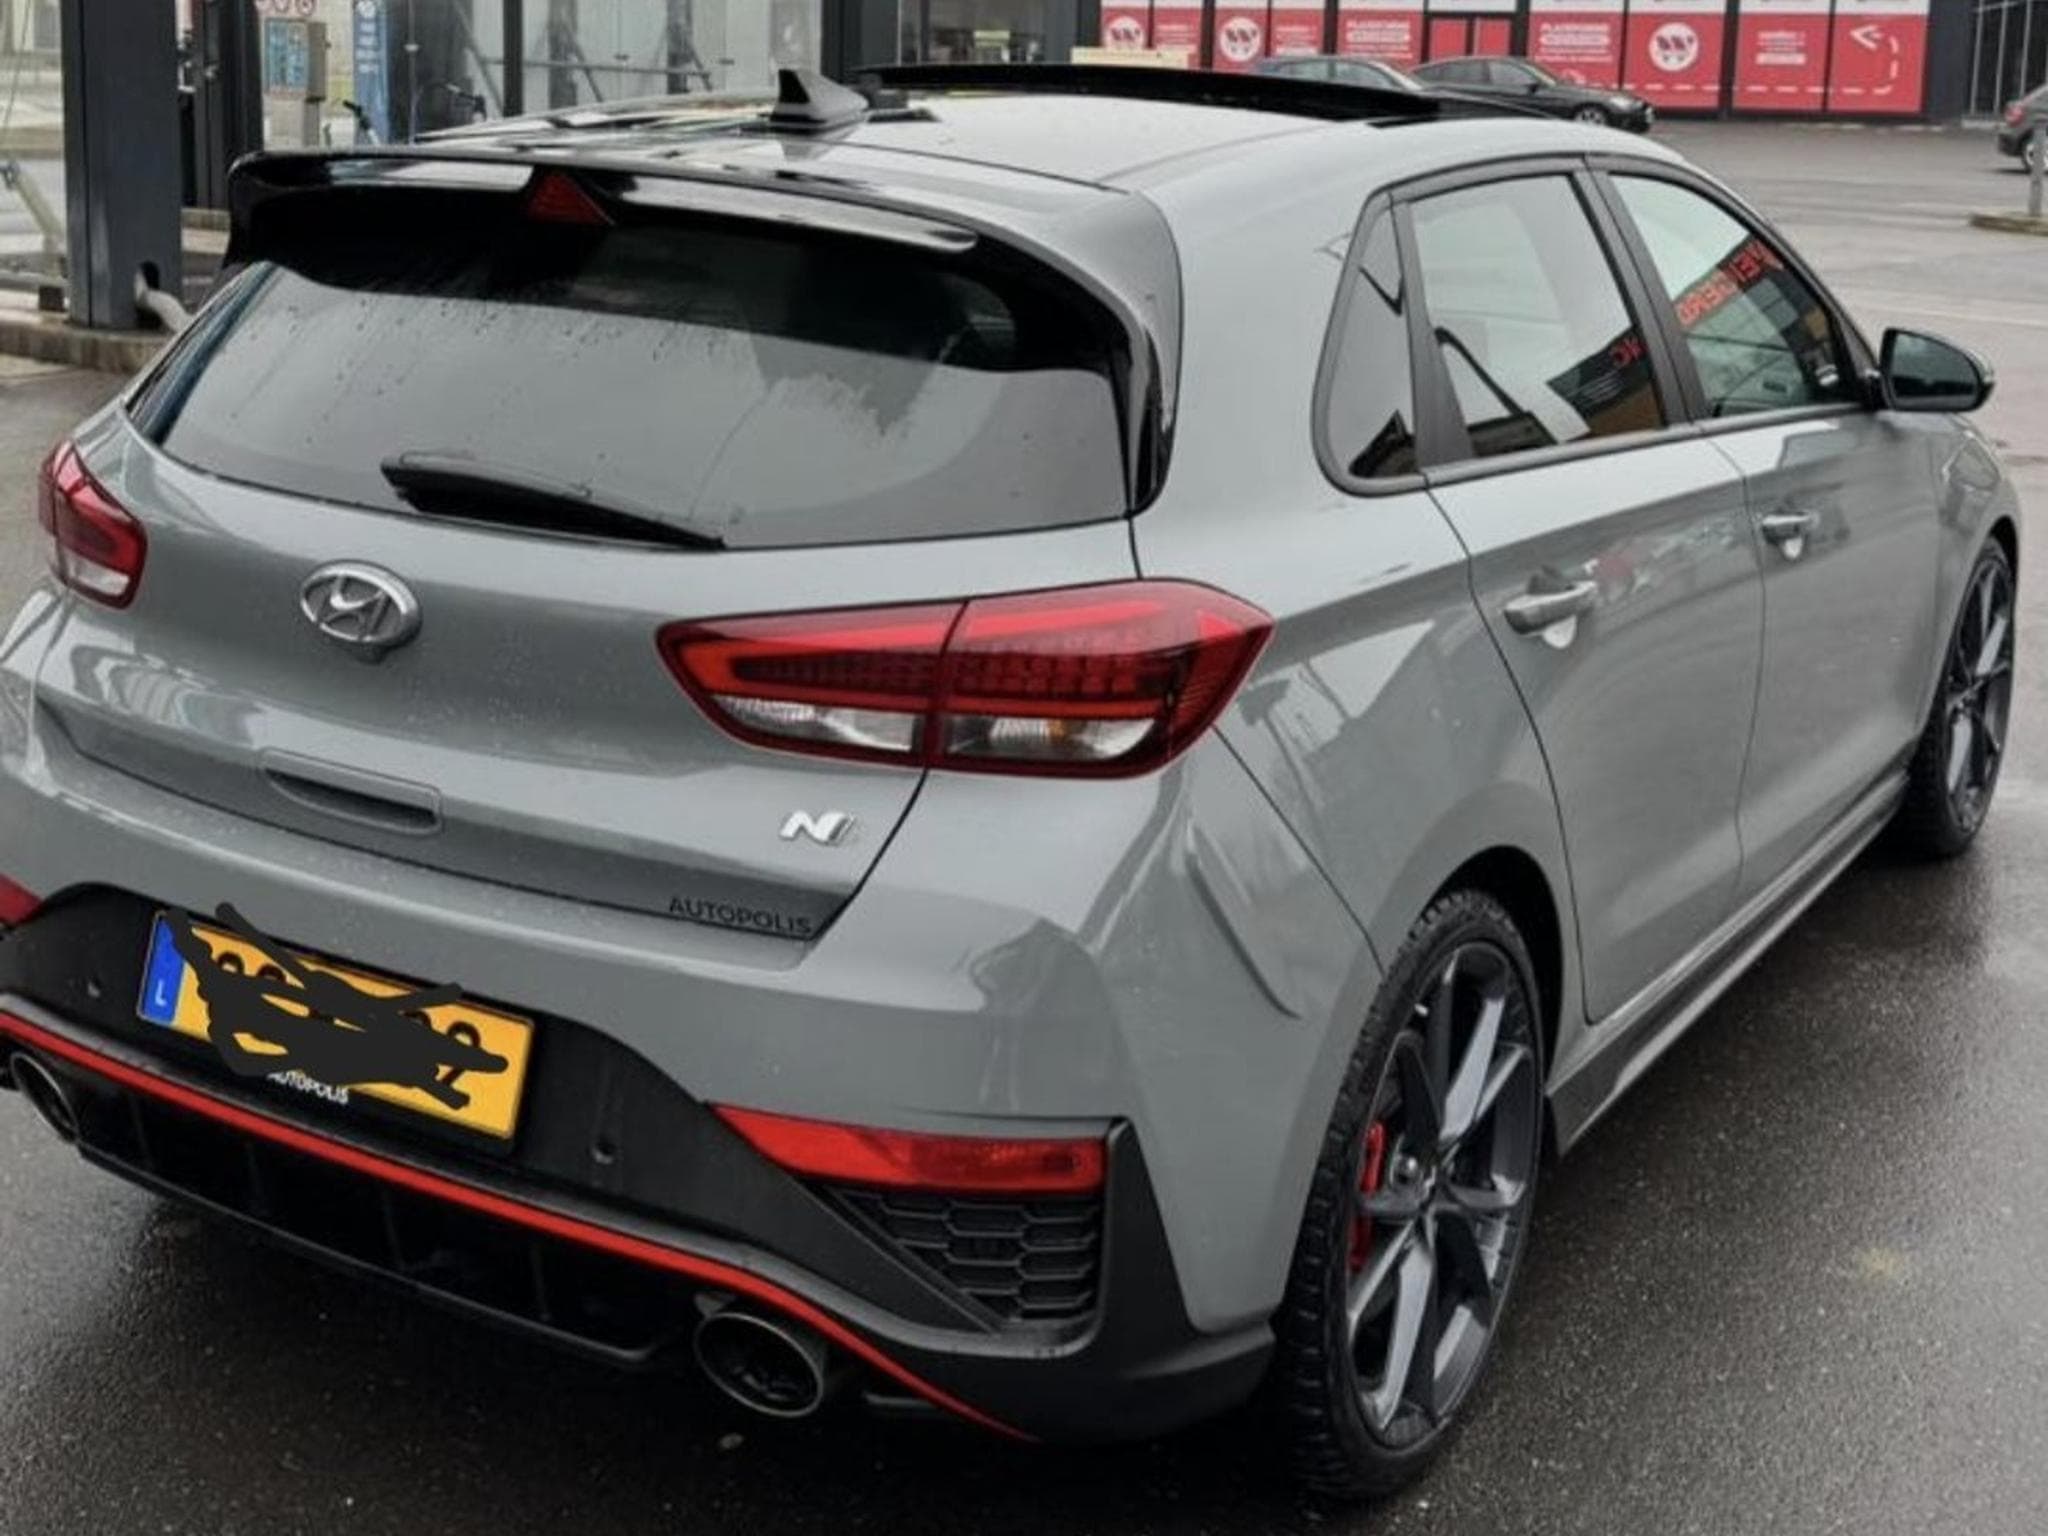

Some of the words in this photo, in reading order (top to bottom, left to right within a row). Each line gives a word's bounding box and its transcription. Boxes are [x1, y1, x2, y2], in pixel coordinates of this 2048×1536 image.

[778, 810, 856, 846] N
[669, 897, 811, 933] AUTOPOLIS
[155, 979, 168, 1007] L
